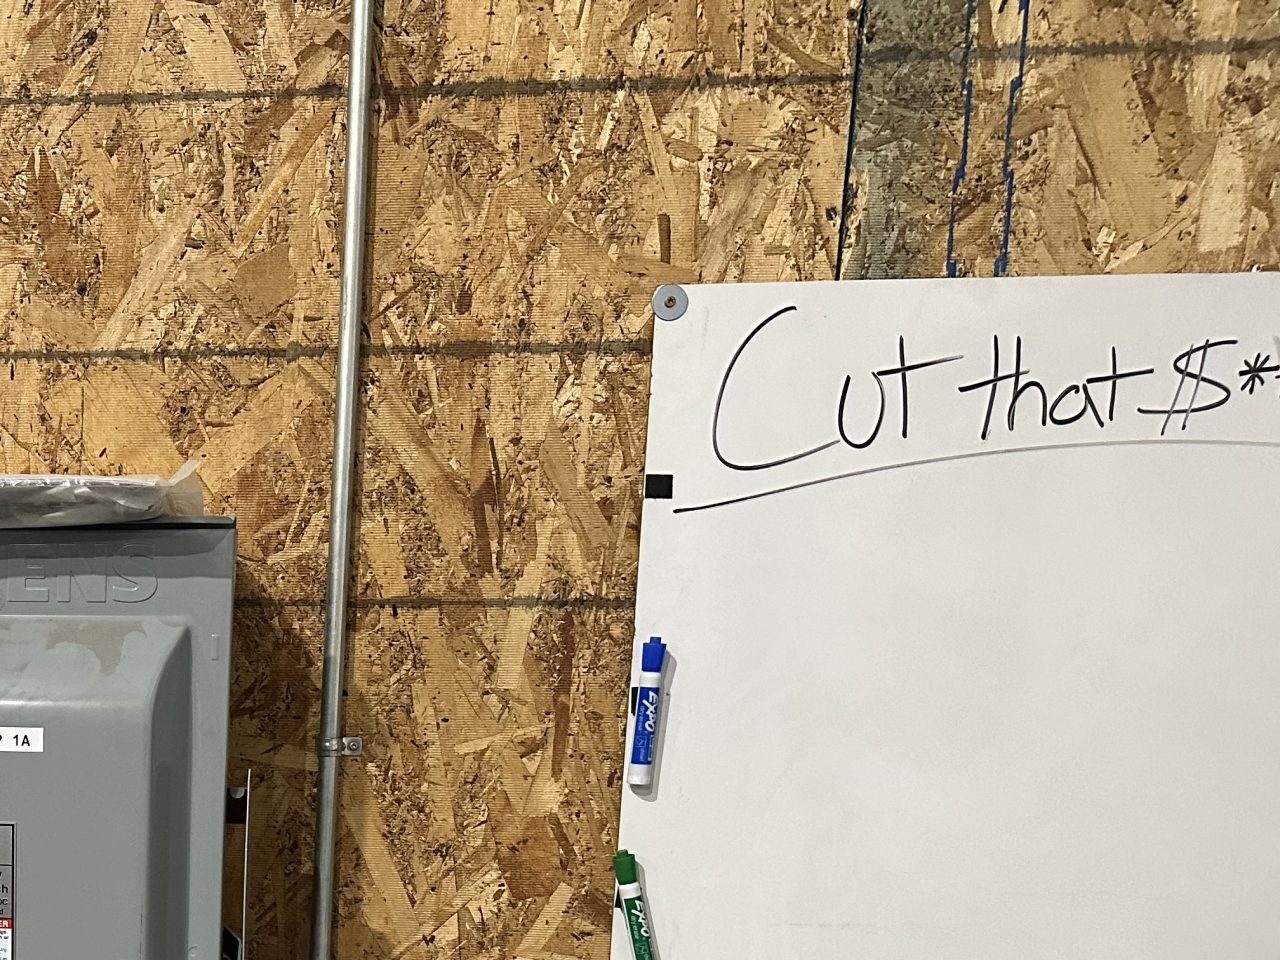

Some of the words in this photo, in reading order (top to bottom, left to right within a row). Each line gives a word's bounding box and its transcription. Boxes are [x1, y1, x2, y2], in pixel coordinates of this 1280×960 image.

[712, 305, 964, 471] Cut
[958, 335, 1154, 440] that
[642, 690, 658, 732] EXPO
[13, 734, 31, 747] 1A
[631, 900, 650, 937] EXPO
